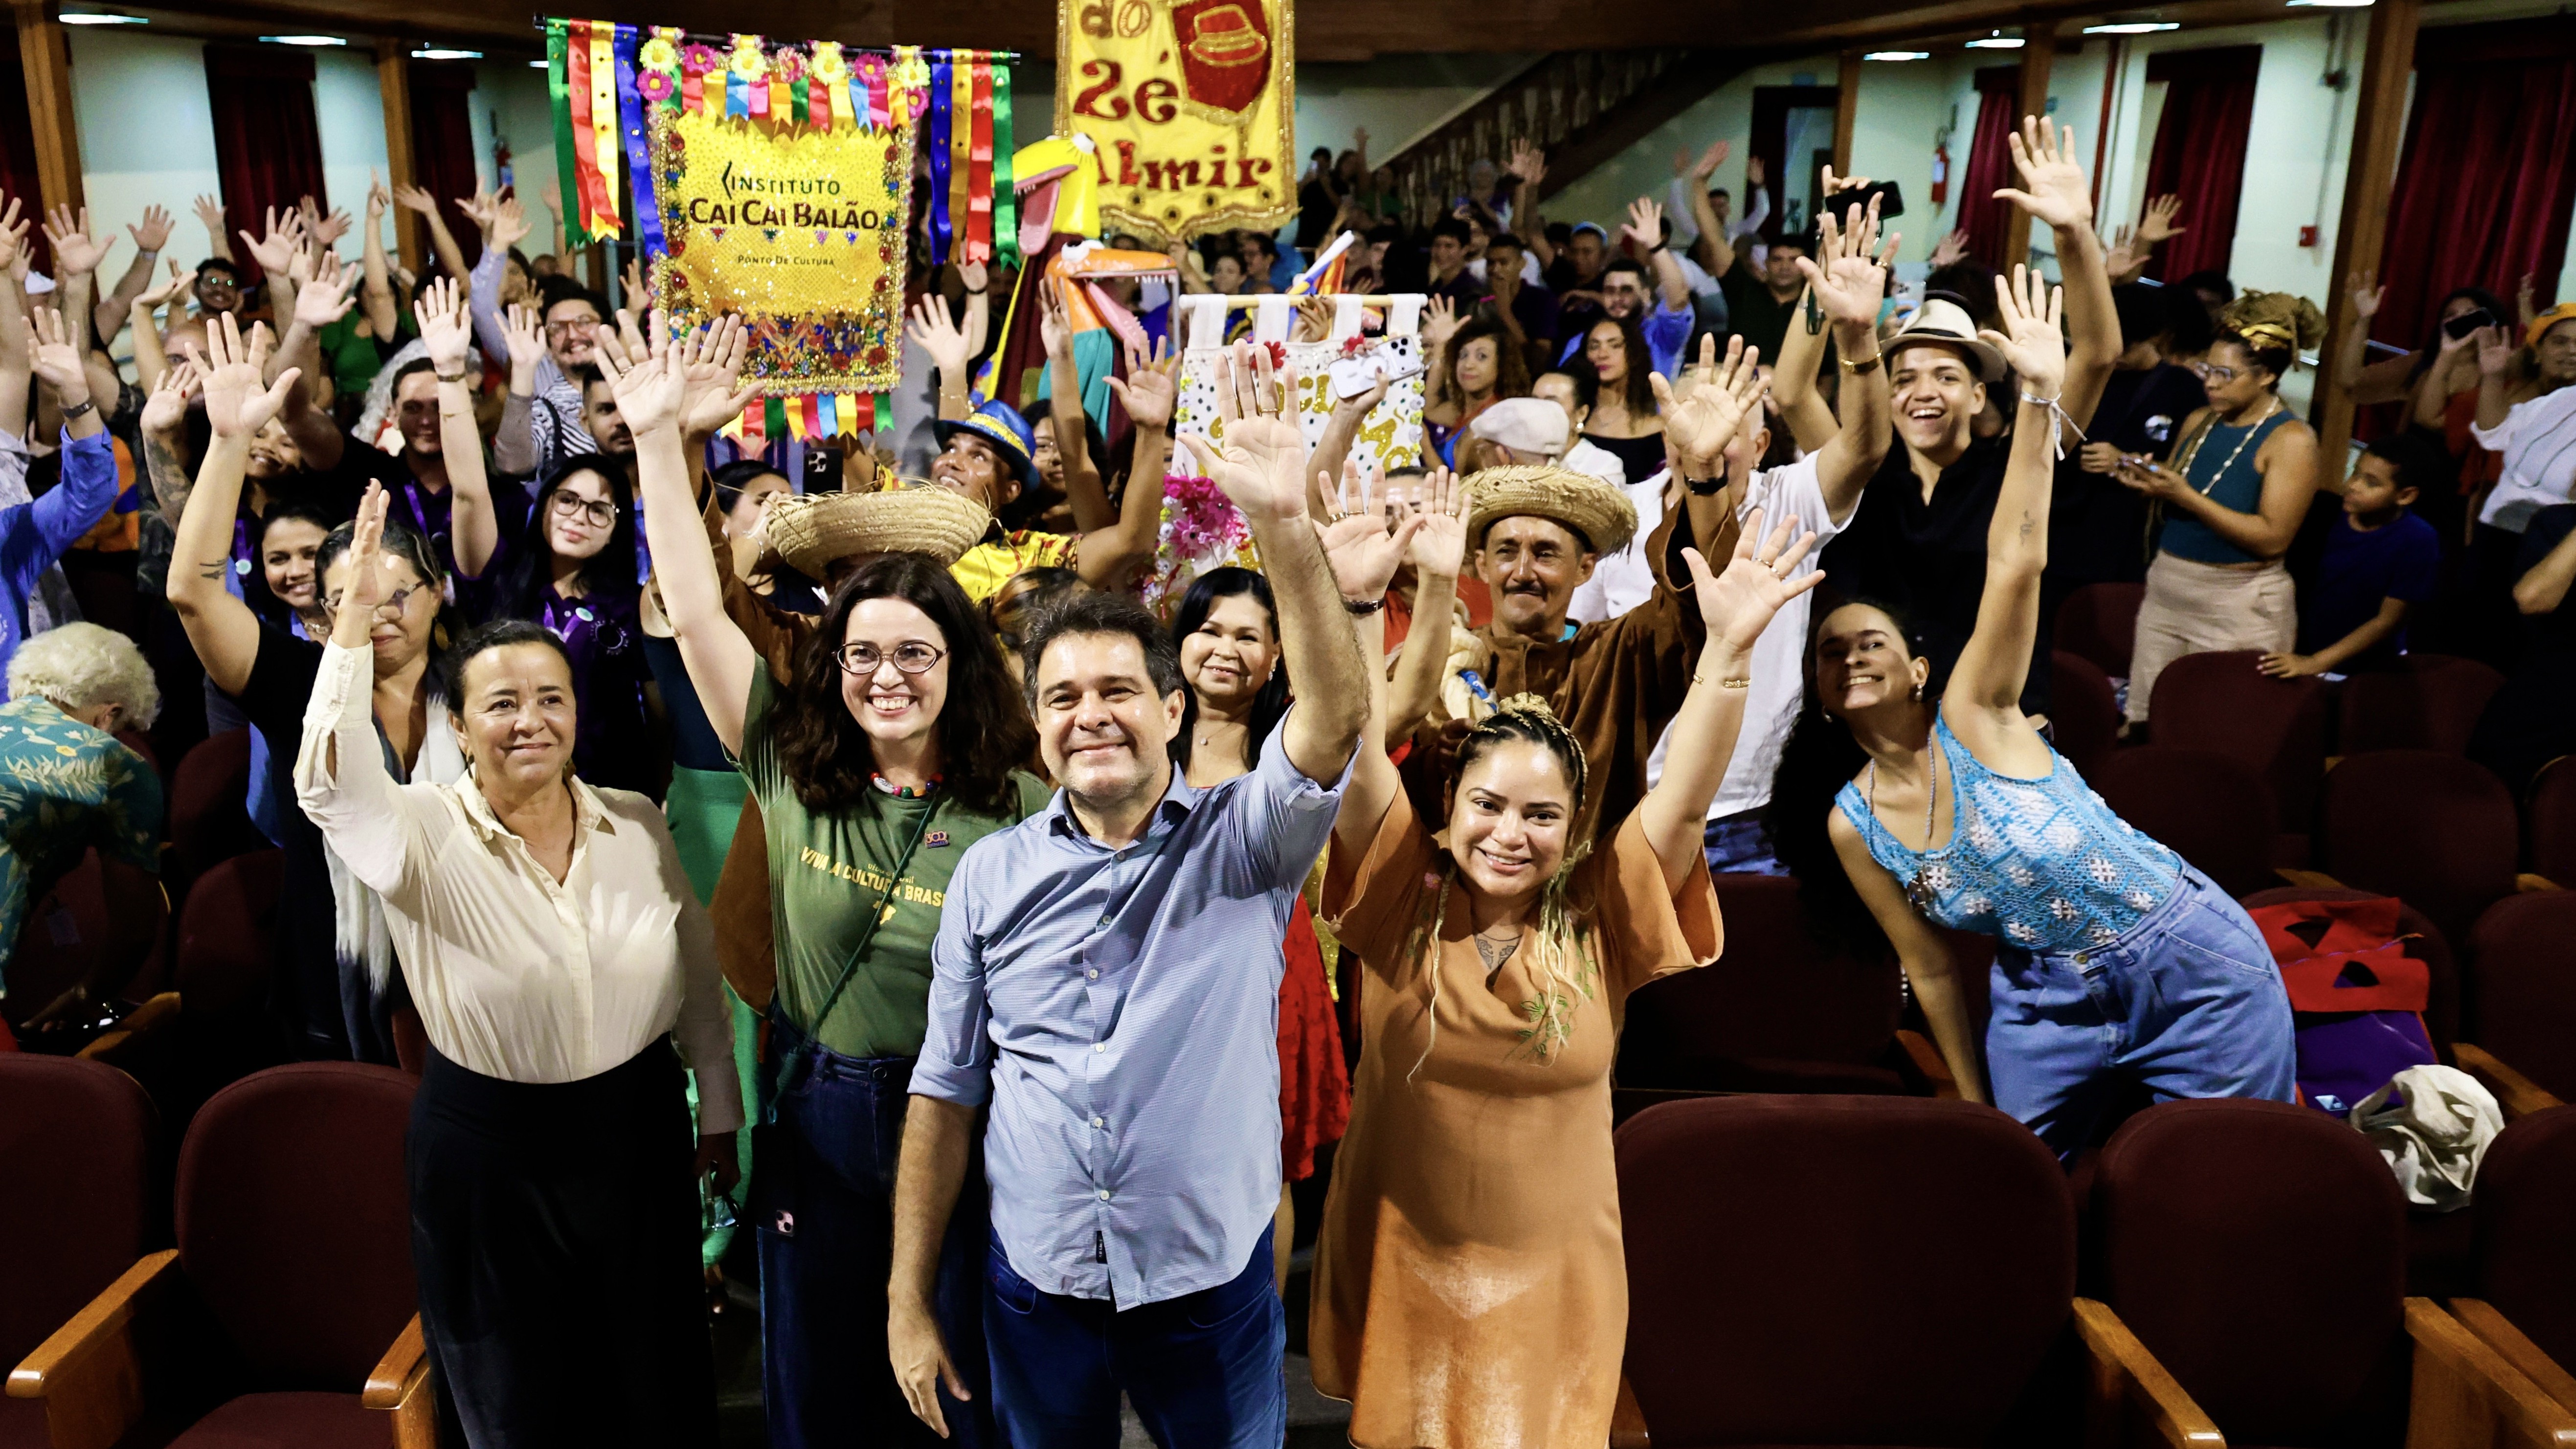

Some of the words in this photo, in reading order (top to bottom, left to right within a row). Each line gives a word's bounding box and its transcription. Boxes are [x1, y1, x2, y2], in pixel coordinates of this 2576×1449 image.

[731, 175, 840, 195] INSTITUTO
[801, 846, 829, 870] VIVA
[828, 862, 841, 876] A
